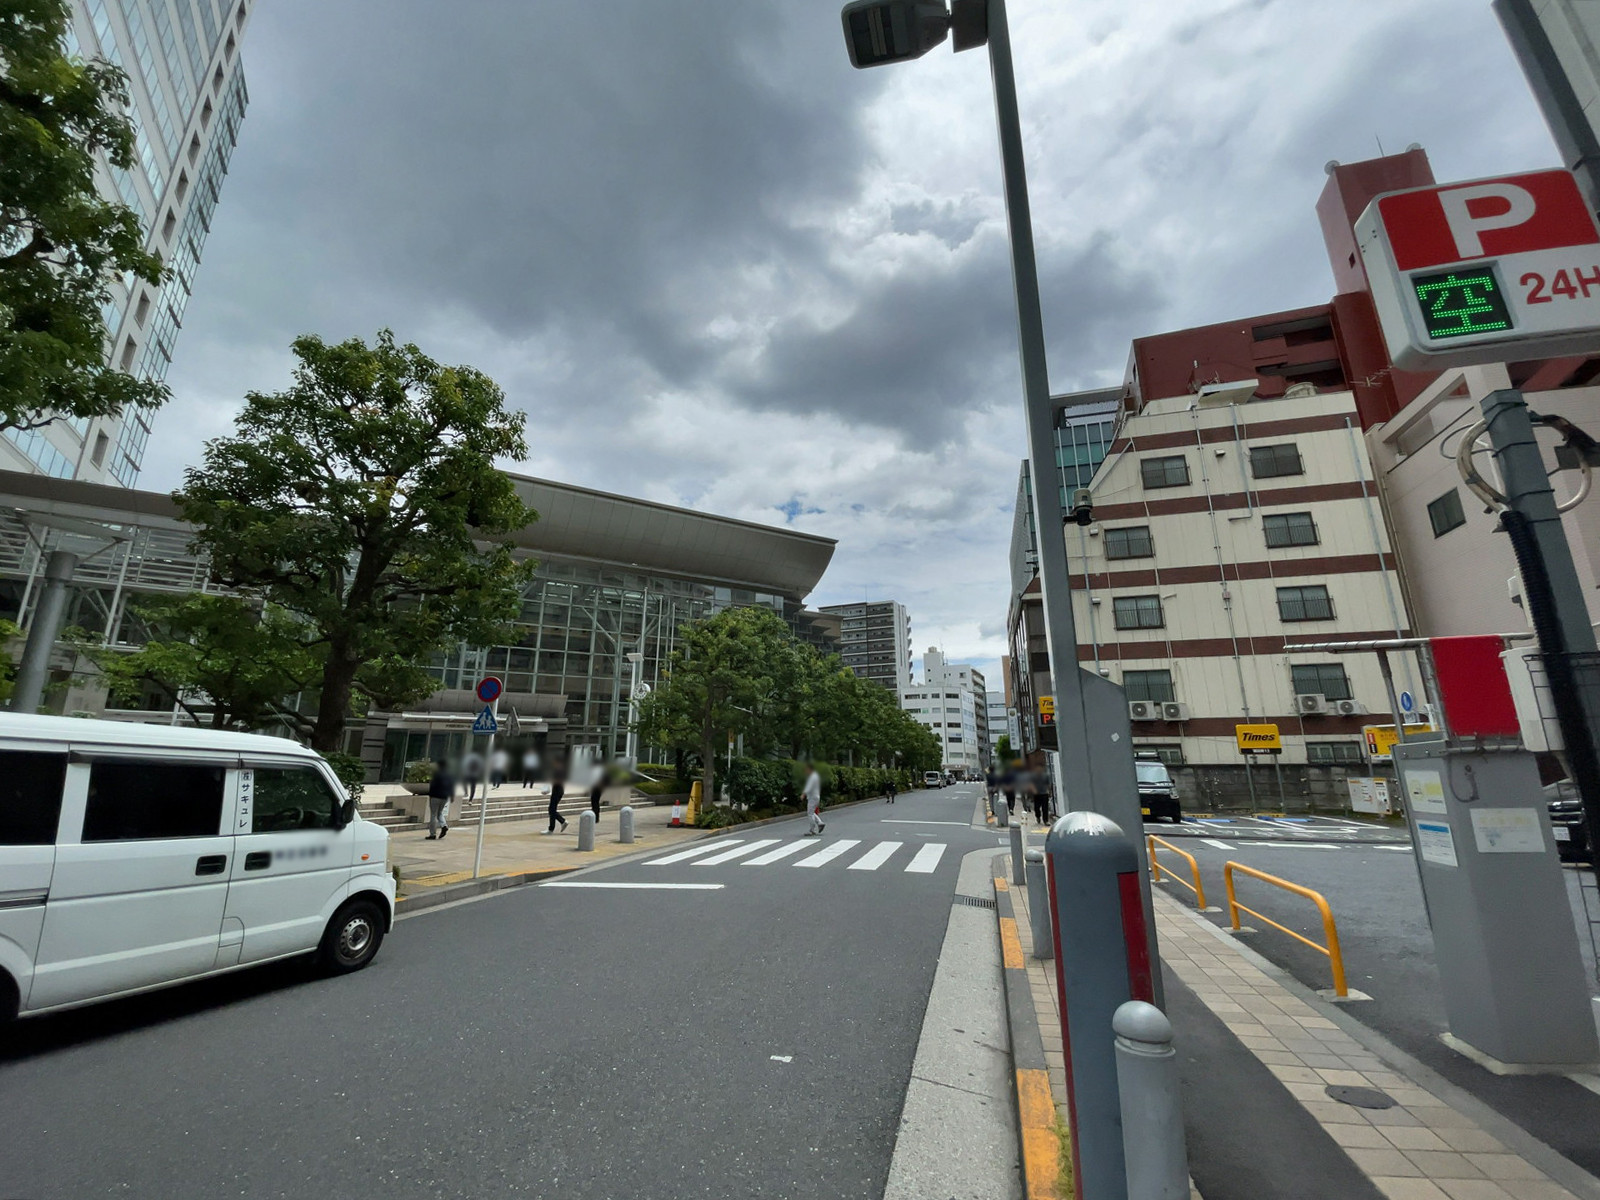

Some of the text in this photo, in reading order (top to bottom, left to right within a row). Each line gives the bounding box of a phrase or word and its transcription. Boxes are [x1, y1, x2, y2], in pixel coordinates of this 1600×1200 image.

[1437, 183, 1536, 259] P
[1416, 275, 1507, 337] 空
[1519, 265, 1600, 305] 24H
[1242, 732, 1276, 742] Times
